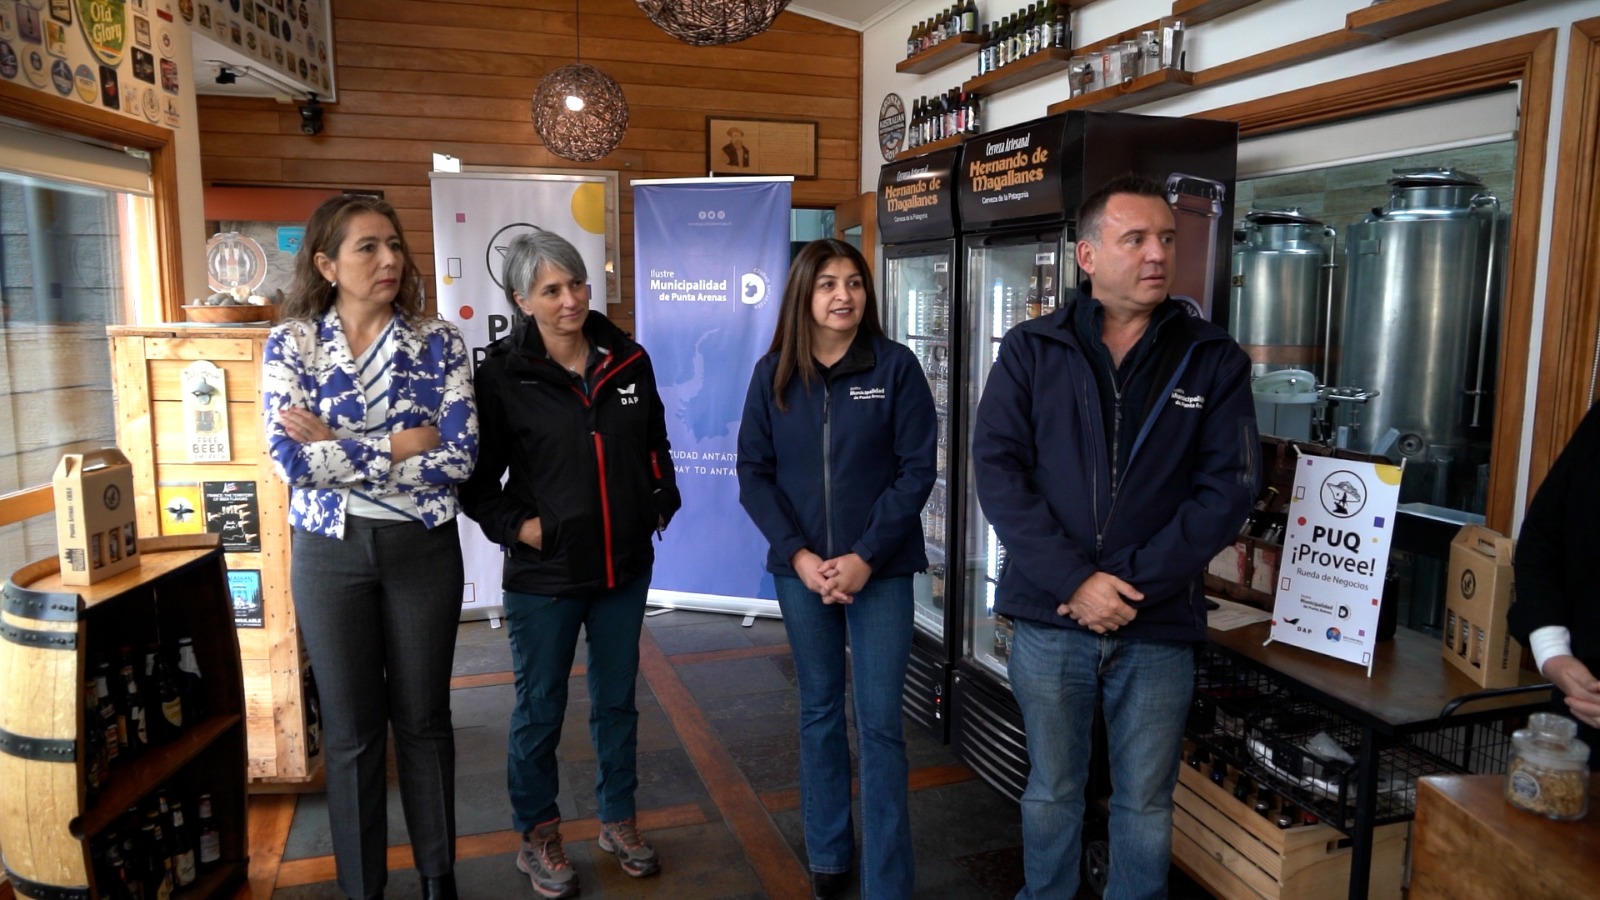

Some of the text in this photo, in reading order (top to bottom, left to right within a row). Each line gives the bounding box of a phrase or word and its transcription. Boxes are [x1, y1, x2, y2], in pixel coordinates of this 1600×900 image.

[91, 2, 113, 22] Old
[92, 23, 122, 45] Glory
[986, 132, 1031, 156] Cerveza Artesanal
[969, 146, 1048, 177] Hernando de
[885, 177, 942, 199] Hernando de
[973, 168, 1044, 192] Magallanes
[887, 194, 939, 213] Magallanes
[982, 196, 998, 204] Cerveza
[998, 194, 1004, 202] de
[1009, 191, 1029, 200] Patagonia
[650, 269, 674, 279] Ilustre
[650, 280, 727, 293] Municipalidad
[659, 293, 727, 302] de Punta Arenas
[620, 396, 638, 405] DAP
[192, 443, 225, 454] BEER
[695, 465, 707, 475] TO
[1312, 525, 1361, 554] PUQ
[1291, 543, 1376, 577] ¡Provee!
[1296, 567, 1369, 591] Rueda de Negocios
[1300, 598, 1334, 610] Municipalidad
[1297, 626, 1312, 634] DAP
